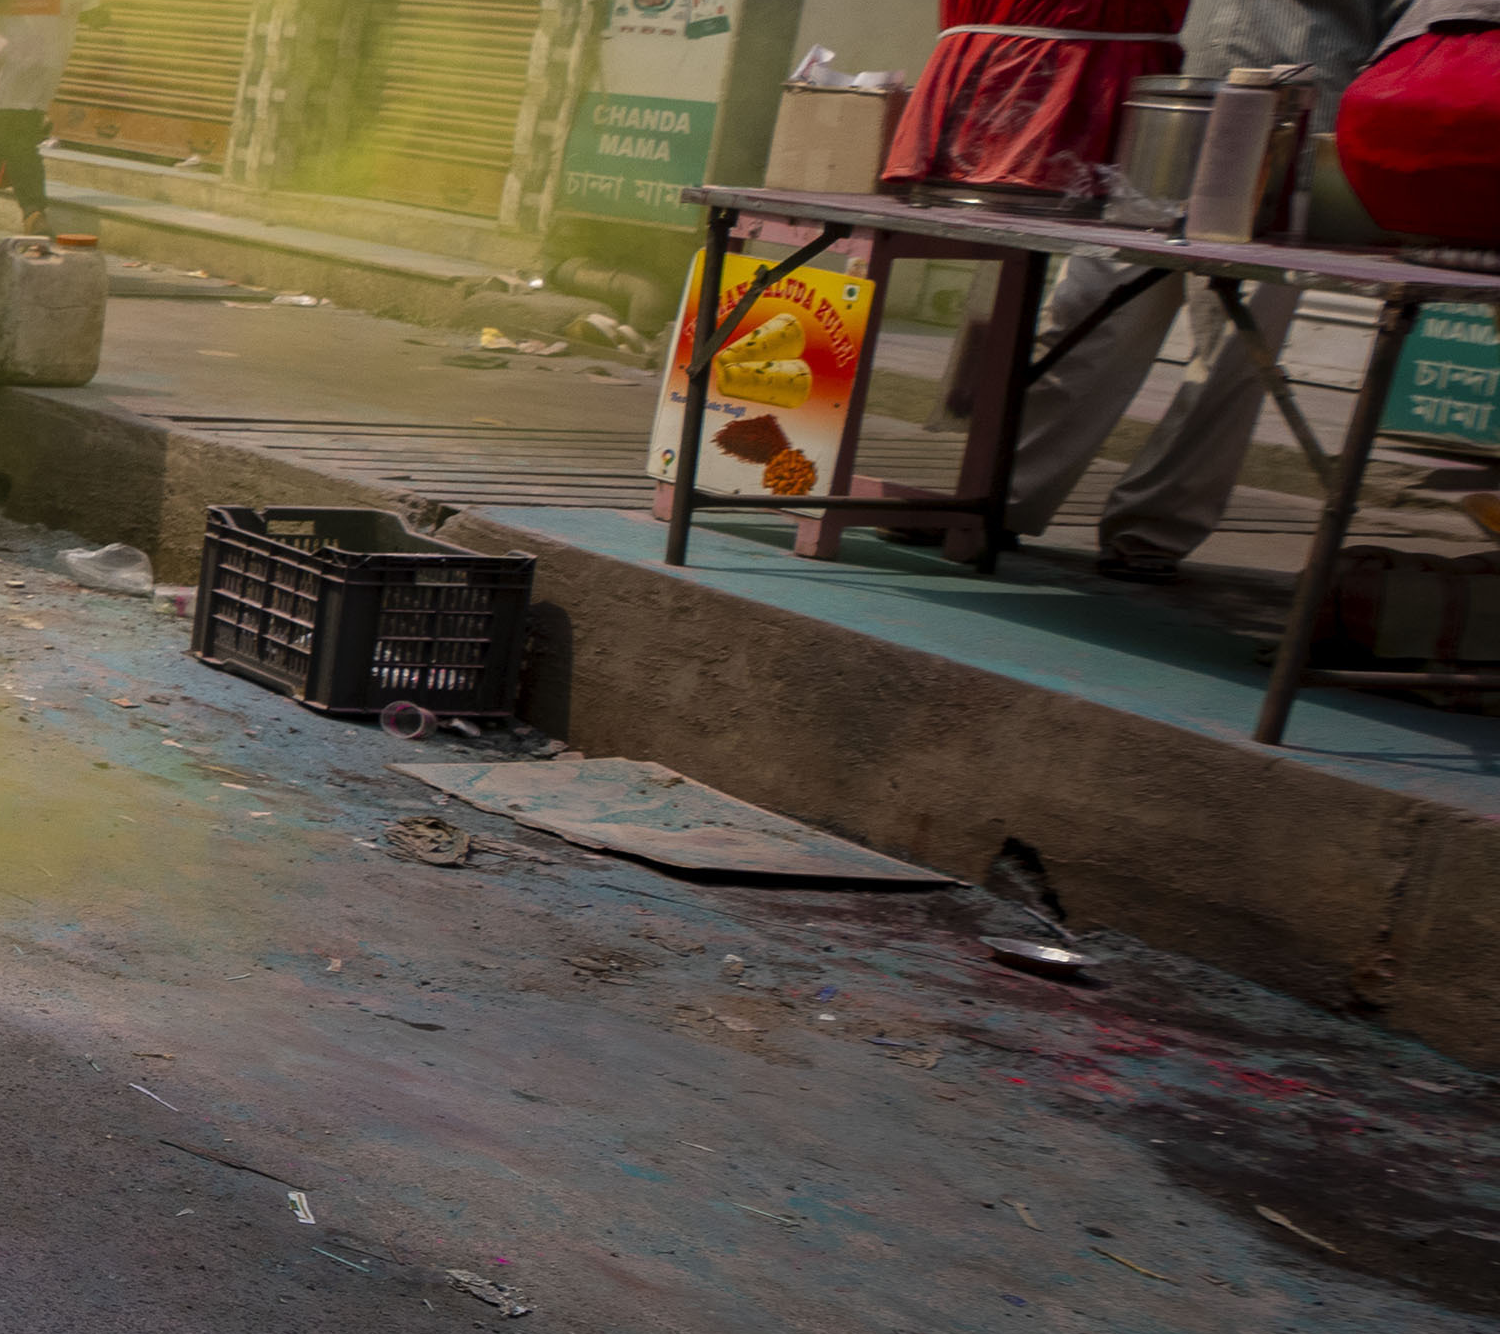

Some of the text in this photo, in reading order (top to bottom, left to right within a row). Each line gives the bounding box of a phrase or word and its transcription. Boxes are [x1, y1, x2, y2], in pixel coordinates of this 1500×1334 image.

[592, 103, 691, 135] CHANDA
[598, 133, 671, 163] MAMA
[565, 170, 626, 202] চান্দা
[1409, 393, 1497, 432] মামা
